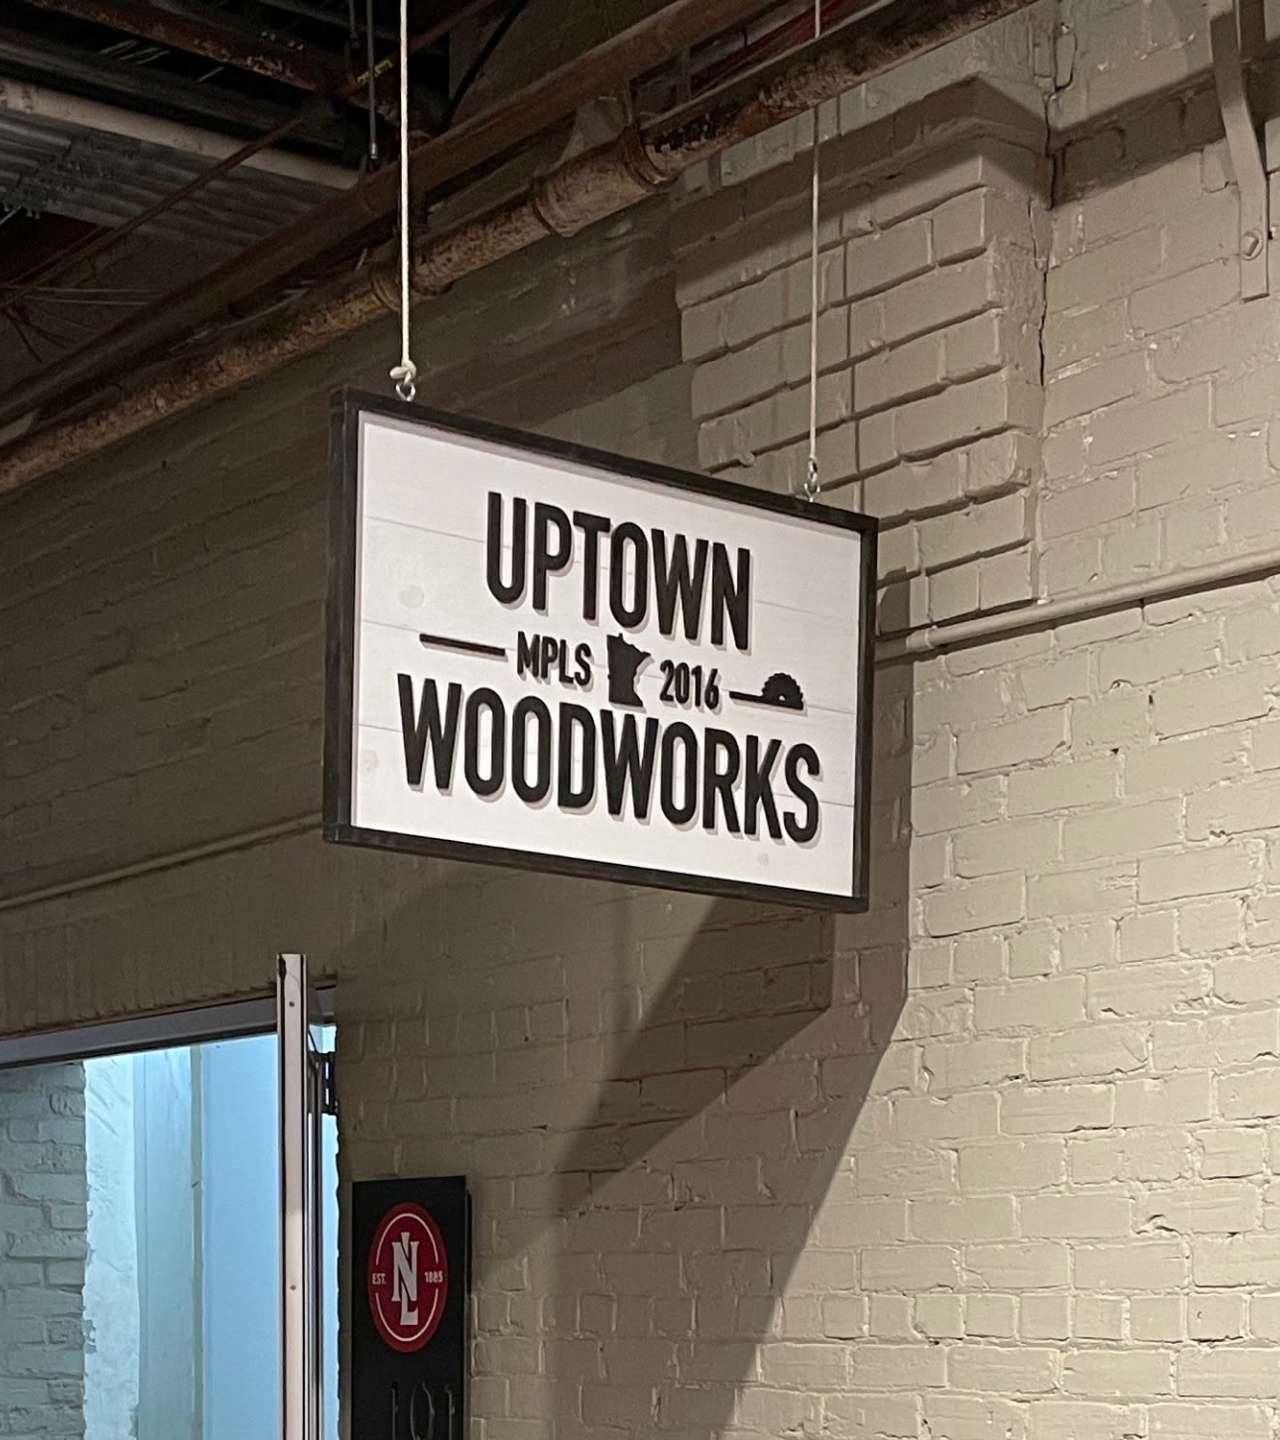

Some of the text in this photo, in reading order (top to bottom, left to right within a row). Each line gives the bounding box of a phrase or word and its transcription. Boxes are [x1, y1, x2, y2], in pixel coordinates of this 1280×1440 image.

[486, 491, 751, 652] UPTOWN
[517, 630, 721, 710] MPLS 2016
[397, 673, 821, 844] WOODWORKS
